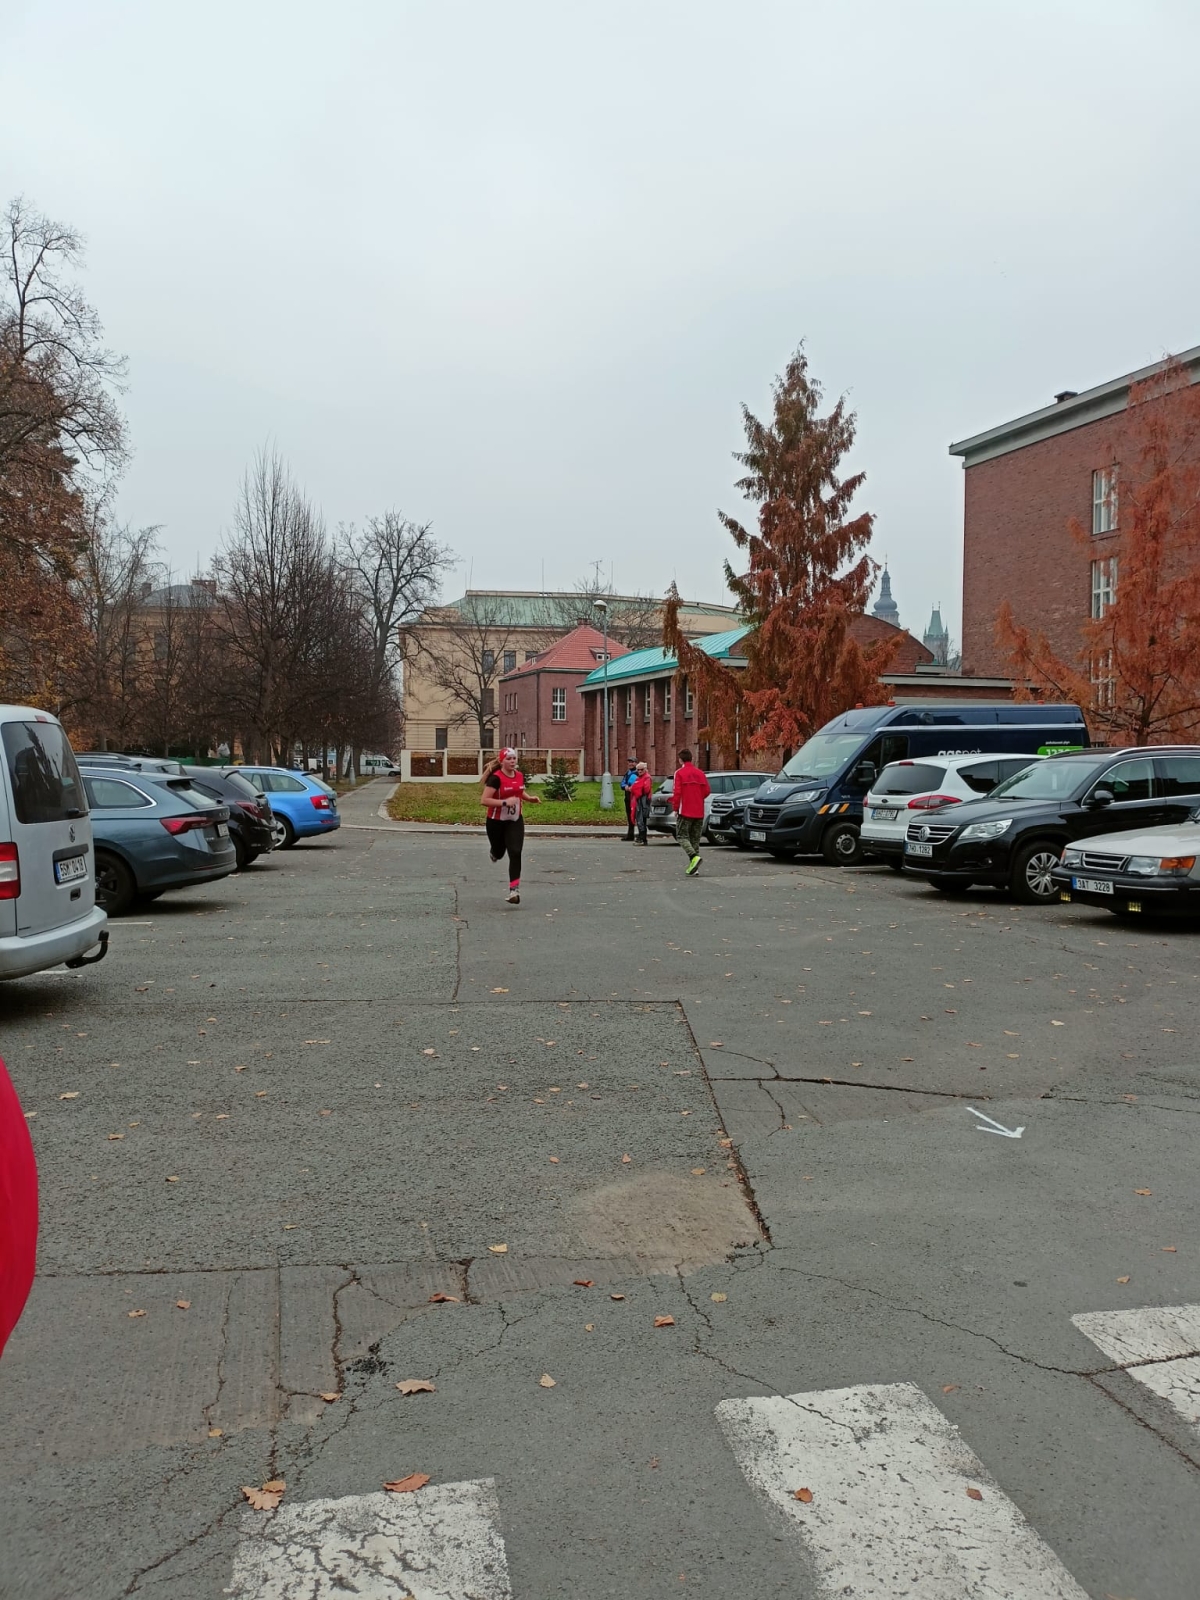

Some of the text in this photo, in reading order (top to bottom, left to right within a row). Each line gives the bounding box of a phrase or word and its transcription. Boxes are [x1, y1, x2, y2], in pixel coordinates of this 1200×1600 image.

[919, 845, 931, 854] 1282
[1077, 879, 1111, 892] 3AT 3228
